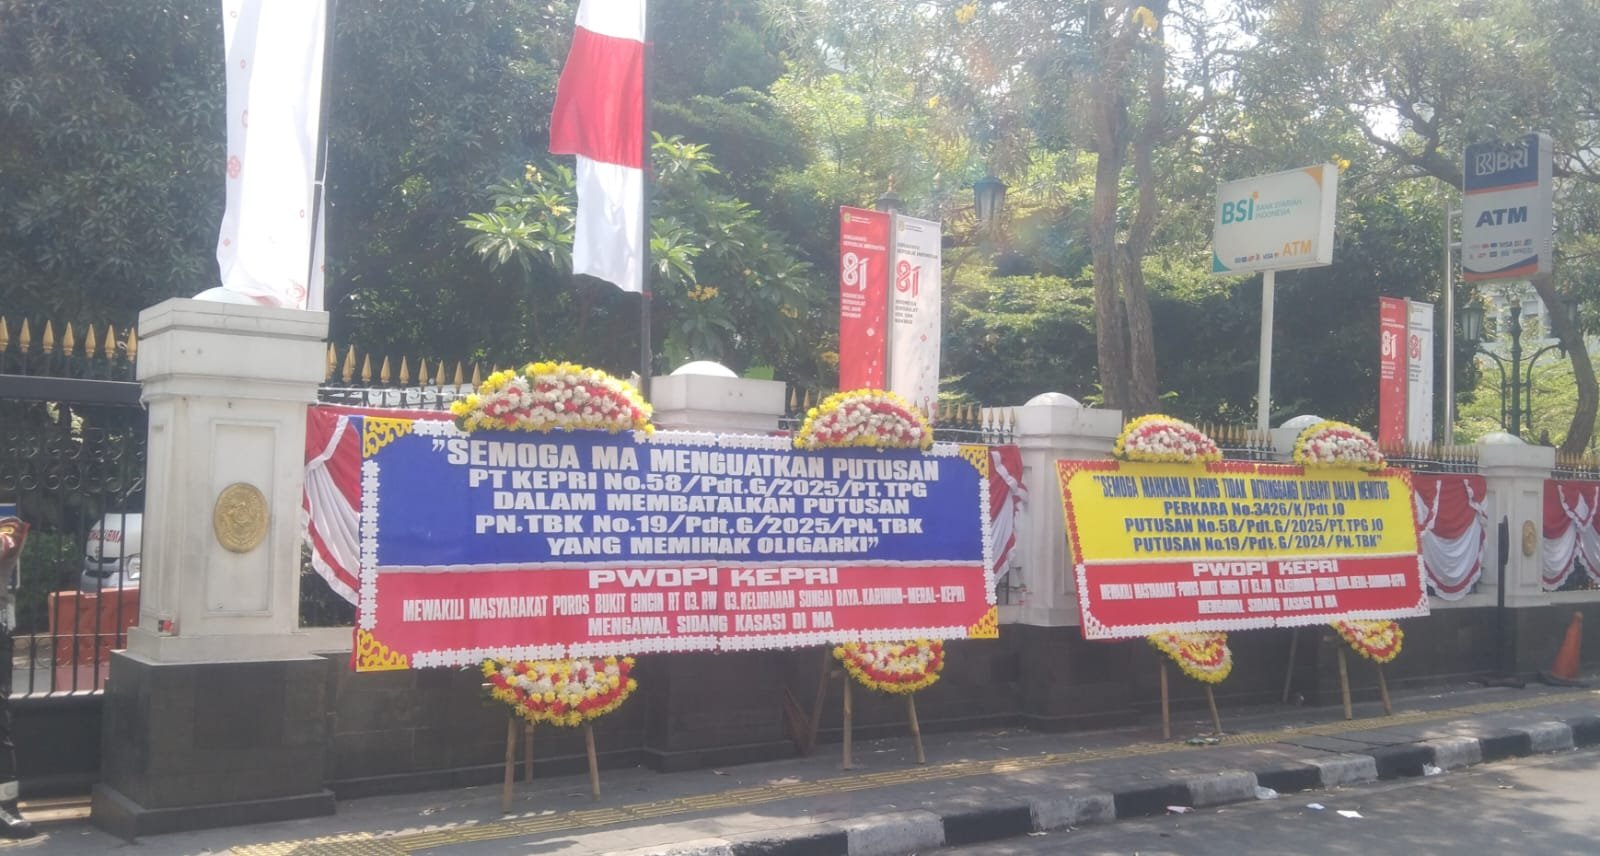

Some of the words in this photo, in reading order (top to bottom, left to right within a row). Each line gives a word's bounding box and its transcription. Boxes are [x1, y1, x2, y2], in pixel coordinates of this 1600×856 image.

[1221, 197, 1254, 224] BSI
[1475, 206, 1528, 227] ATM
[1283, 240, 1312, 257] ATM
[842, 252, 869, 292] 81
[896, 260, 921, 298] 81
[1382, 331, 1397, 359] 81
[592, 446, 639, 470] MA
[651, 449, 825, 479] MENGUATKAN
[832, 458, 939, 481] PUTUSAN
[469, 469, 507, 488] PT
[512, 470, 597, 490] KEPRI
[494, 492, 596, 510] DALAM
[607, 494, 796, 514] MEMBATALKAN
[803, 498, 909, 514] PUTUSAN
[1164, 501, 1228, 515] PERKARA
[1332, 503, 1345, 516] JO
[476, 515, 584, 534] PN.TBK
[1125, 518, 1192, 532] PUTUSAN
[1372, 518, 1383, 531] JO
[547, 537, 621, 556] YANG
[630, 536, 751, 554] MEMIHAK
[1134, 537, 1200, 552] PUTUSAN
[731, 567, 838, 587] KEPRI
[1279, 559, 1339, 575] KEPRI
[403, 598, 464, 622] MEWAKILI
[469, 595, 548, 620] MASYARAKAT
[553, 594, 589, 616] POROS
[668, 592, 680, 611] RT
[701, 591, 717, 610] RW
[588, 616, 670, 636] MENGAWAL
[677, 615, 728, 633] SIDANG
[735, 613, 786, 632] KASASI
[792, 612, 806, 628] DI
[812, 611, 834, 628] MA
